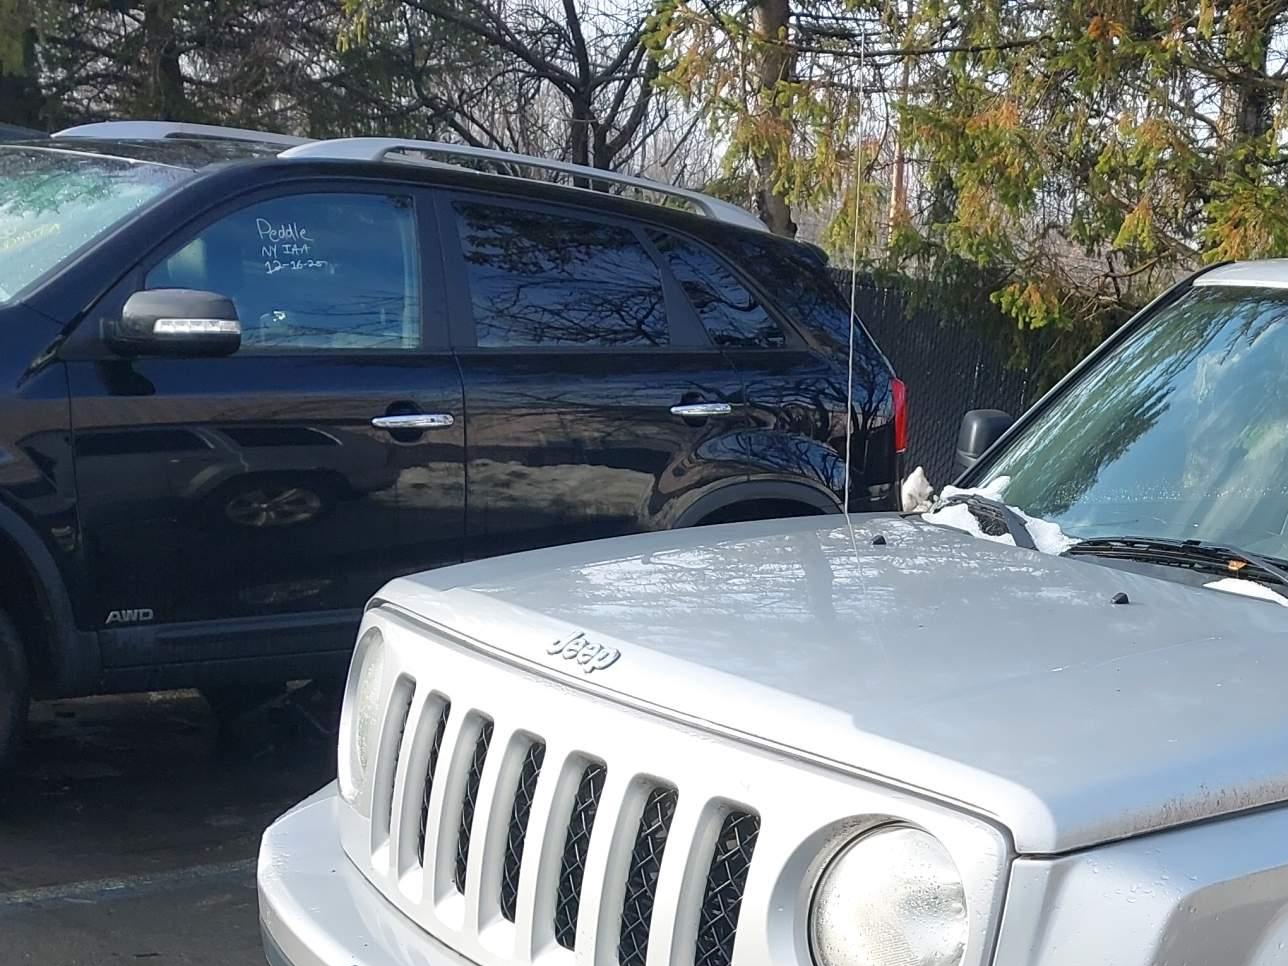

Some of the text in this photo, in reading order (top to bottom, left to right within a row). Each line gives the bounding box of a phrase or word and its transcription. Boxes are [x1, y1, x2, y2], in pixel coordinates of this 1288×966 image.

[256, 218, 315, 242] Peddle
[261, 244, 311, 259] NY IAA
[105, 608, 154, 624] AWD
[546, 631, 622, 674] Jeep
